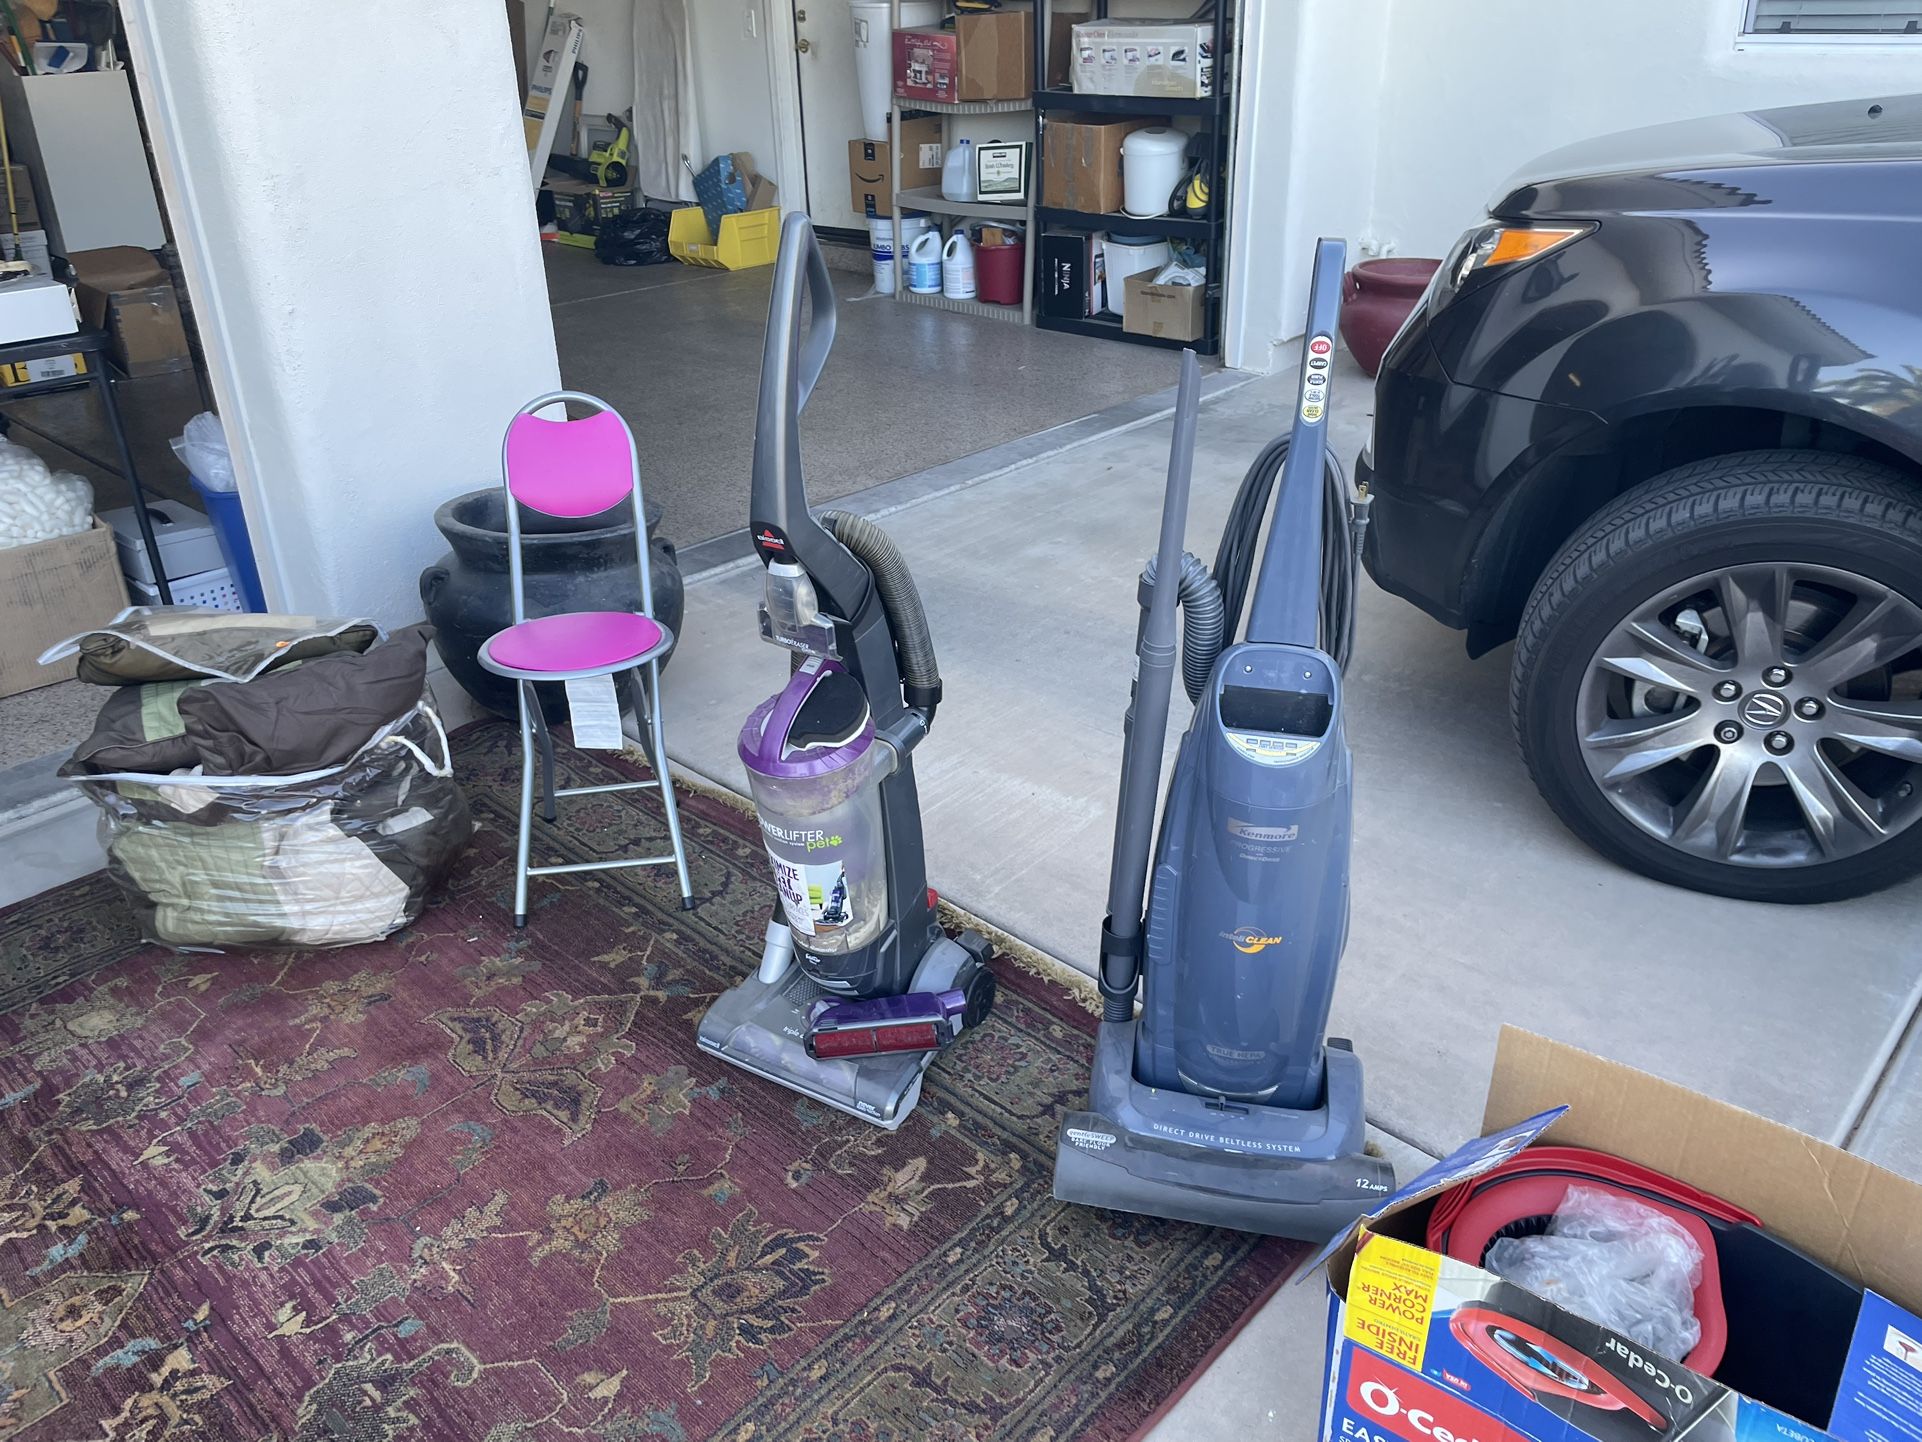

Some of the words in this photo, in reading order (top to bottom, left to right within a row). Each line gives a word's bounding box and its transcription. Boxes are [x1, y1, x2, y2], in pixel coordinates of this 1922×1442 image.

[1061, 263, 1071, 289] NINJA
[806, 837, 829, 853] pet
[1239, 828, 1296, 839] Kenmore
[1153, 1123, 1185, 1136] DIRECT
[1188, 1131, 1215, 1142] DRIVE
[1219, 1136, 1262, 1149] BELTLESS
[1266, 1143, 1301, 1152] SYSTEM
[1355, 1178, 1369, 1189] 12
[1369, 1184, 1388, 1192] AMPS
[1361, 1282, 1426, 1313] CORNER
[1391, 1283, 1428, 1304] MAX
[1368, 1295, 1424, 1325] POWER
[1356, 1317, 1420, 1354] INSIDE
[1375, 1337, 1417, 1366] FREE
[1605, 1338, 1693, 1404] O-Cedar
